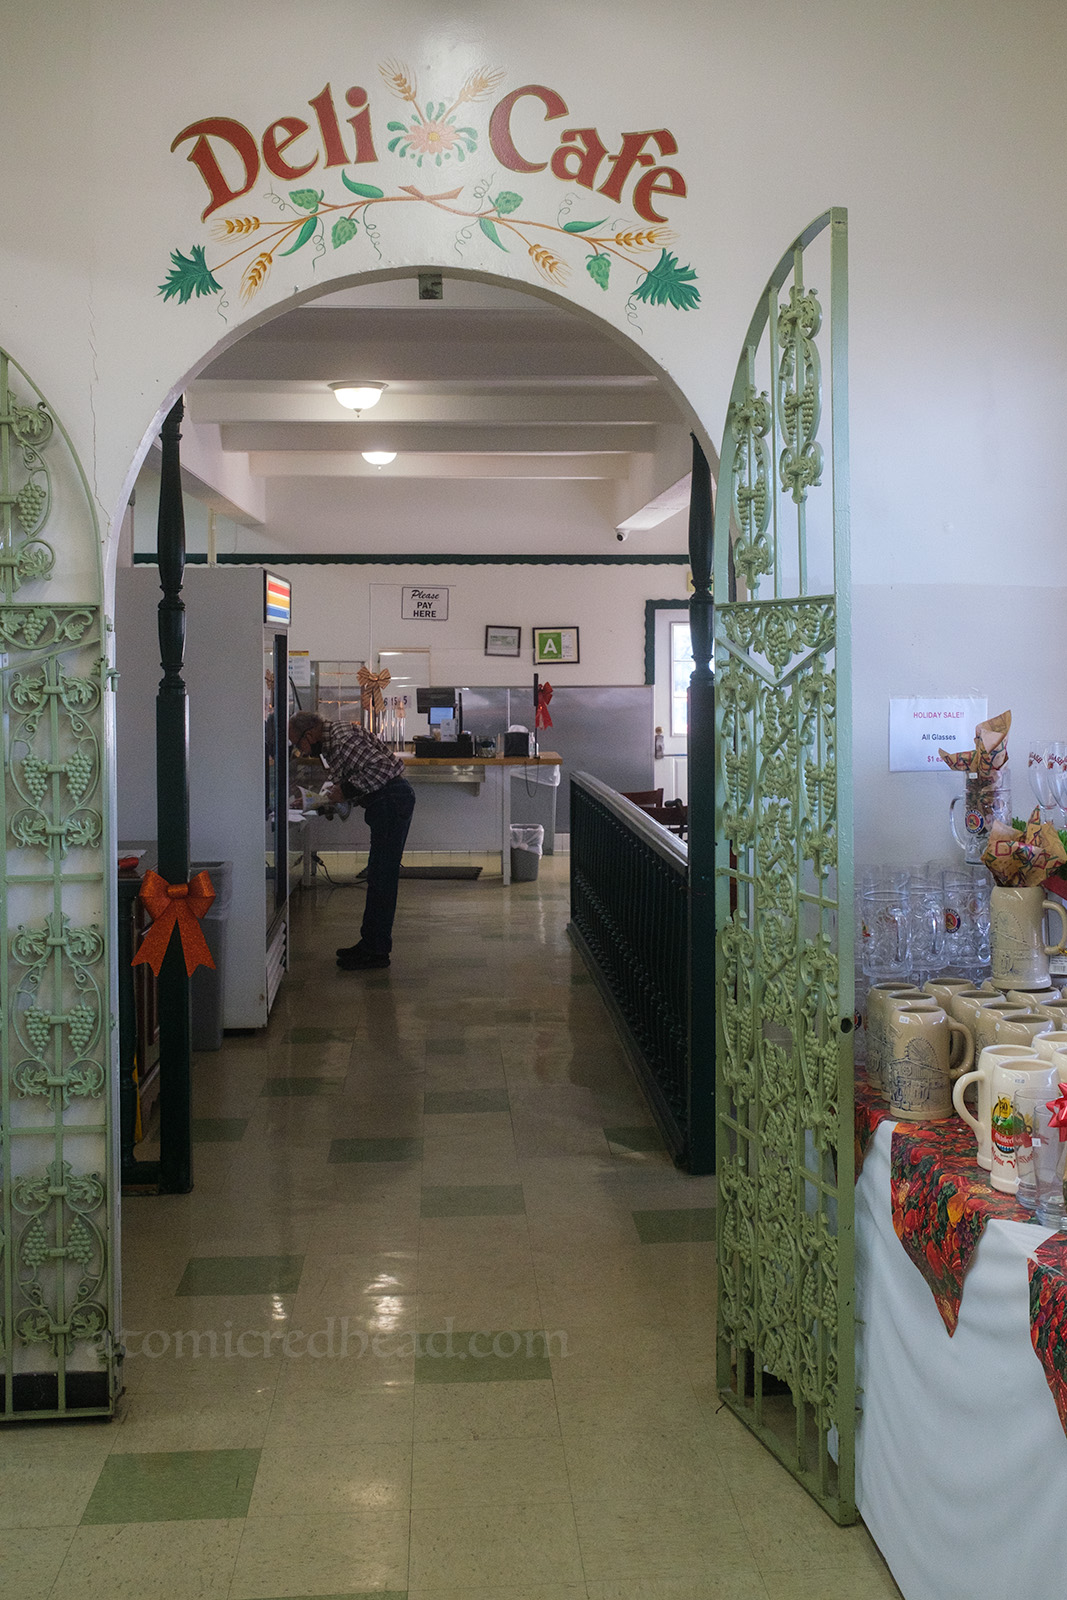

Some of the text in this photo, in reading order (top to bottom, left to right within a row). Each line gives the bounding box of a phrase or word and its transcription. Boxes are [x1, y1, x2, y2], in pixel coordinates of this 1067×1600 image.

[170, 82, 688, 224] Deli Cafe
[411, 589, 439, 600] Please
[417, 601, 433, 609] PAY
[413, 610, 437, 618] HERE
[543, 638, 558, 654] A
[913, 711, 942, 719] HOLIDAY
[931, 733, 956, 741] Glasses
[927, 755, 935, 763] $1
